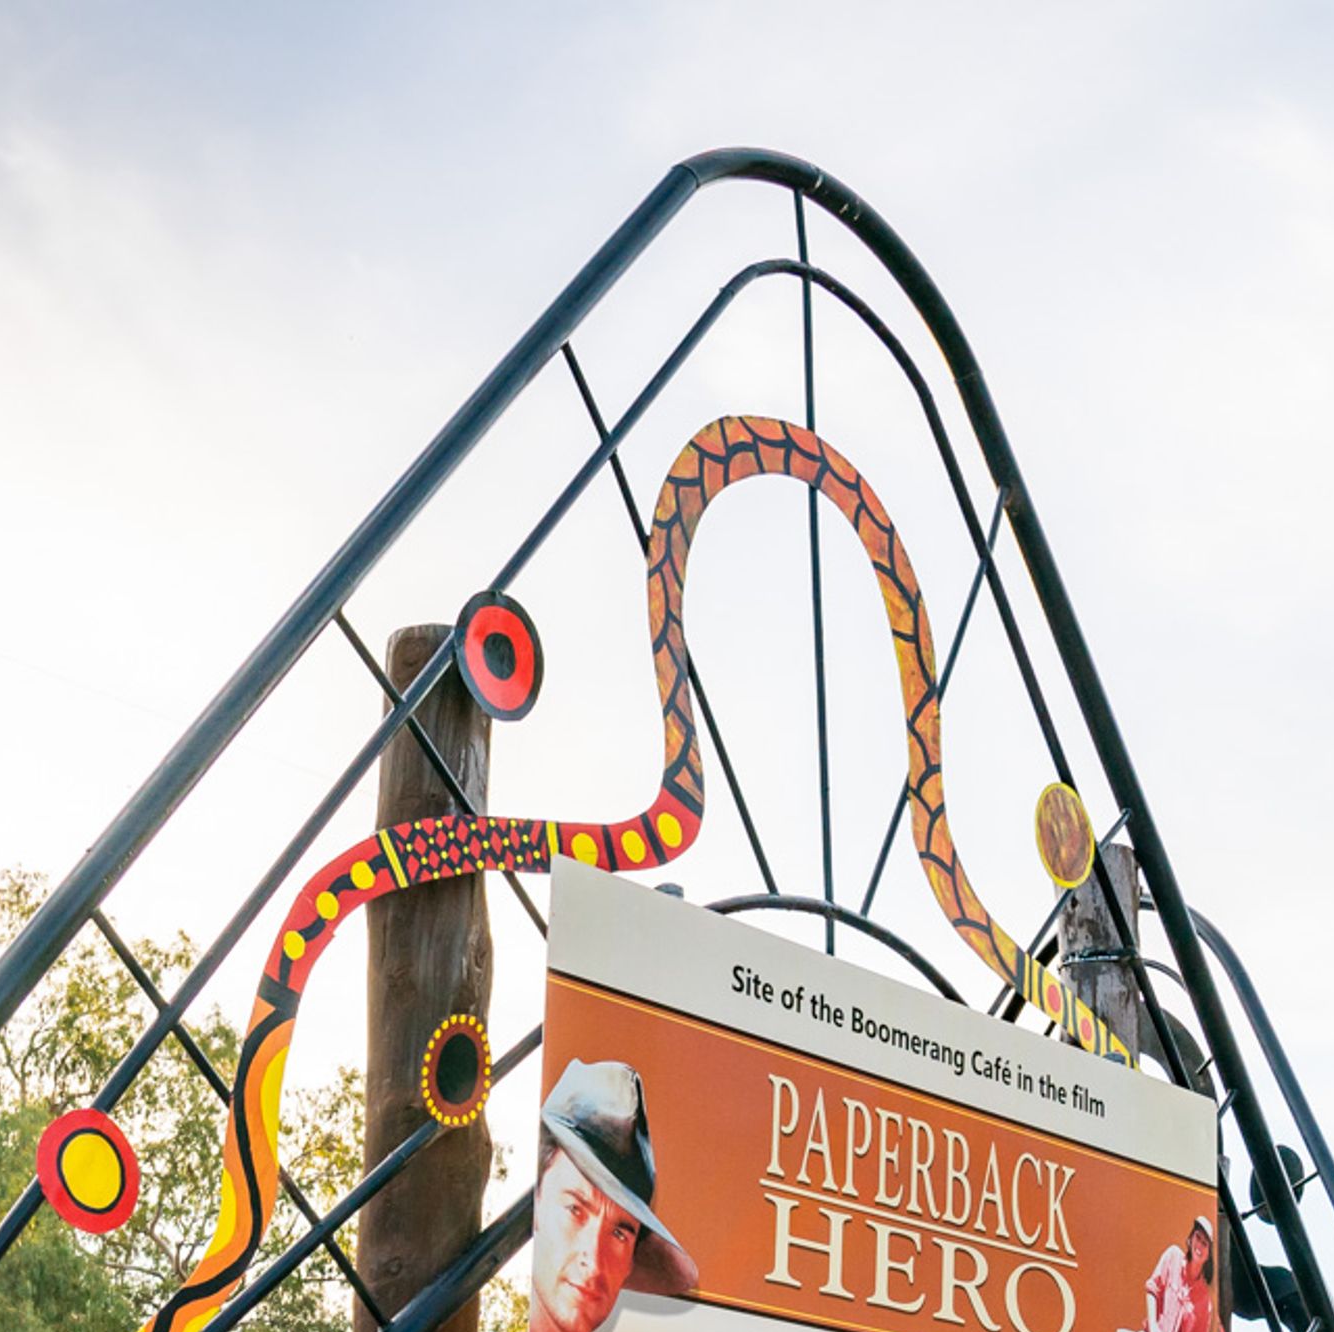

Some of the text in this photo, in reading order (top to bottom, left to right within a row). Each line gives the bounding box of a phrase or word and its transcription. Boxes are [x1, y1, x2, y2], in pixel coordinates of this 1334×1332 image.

[732, 965, 1105, 1118] Site of the Boomerang Café in the film
[767, 1073, 1076, 1256] PAPERBACK
